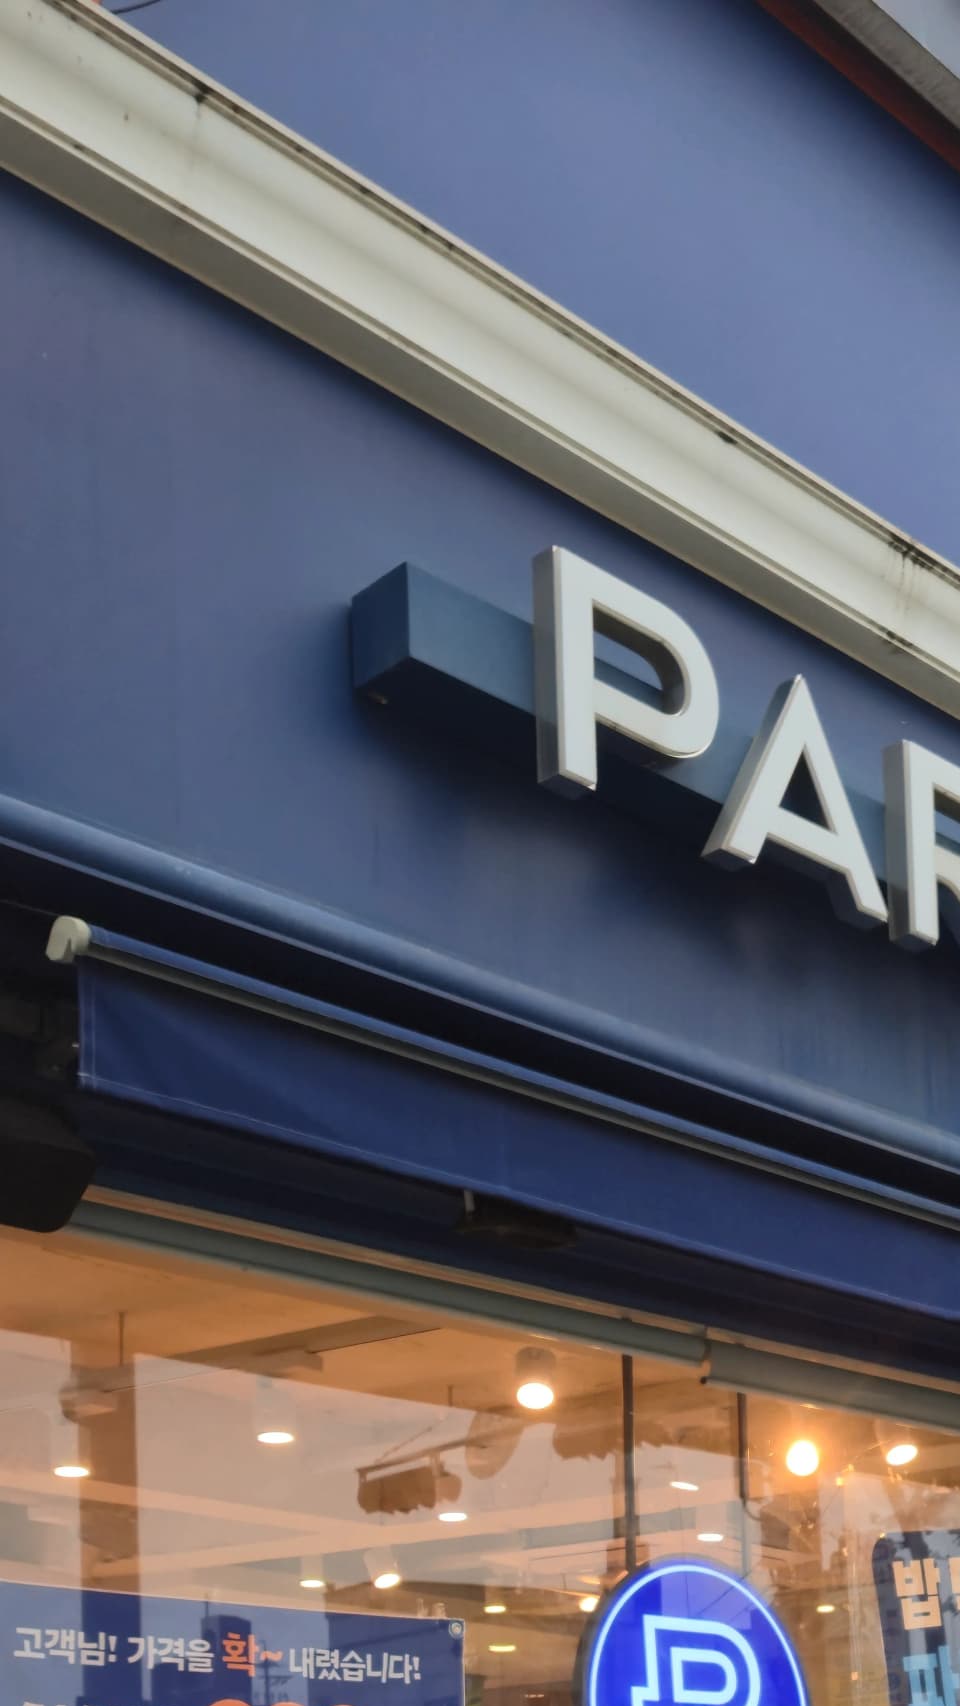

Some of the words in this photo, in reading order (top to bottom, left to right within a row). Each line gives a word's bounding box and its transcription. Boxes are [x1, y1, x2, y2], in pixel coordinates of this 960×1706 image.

[13, 1627, 117, 1666] 고객님!
[127, 1636, 215, 1674] 가격을
[289, 1647, 421, 1685] 내렸습니다!
